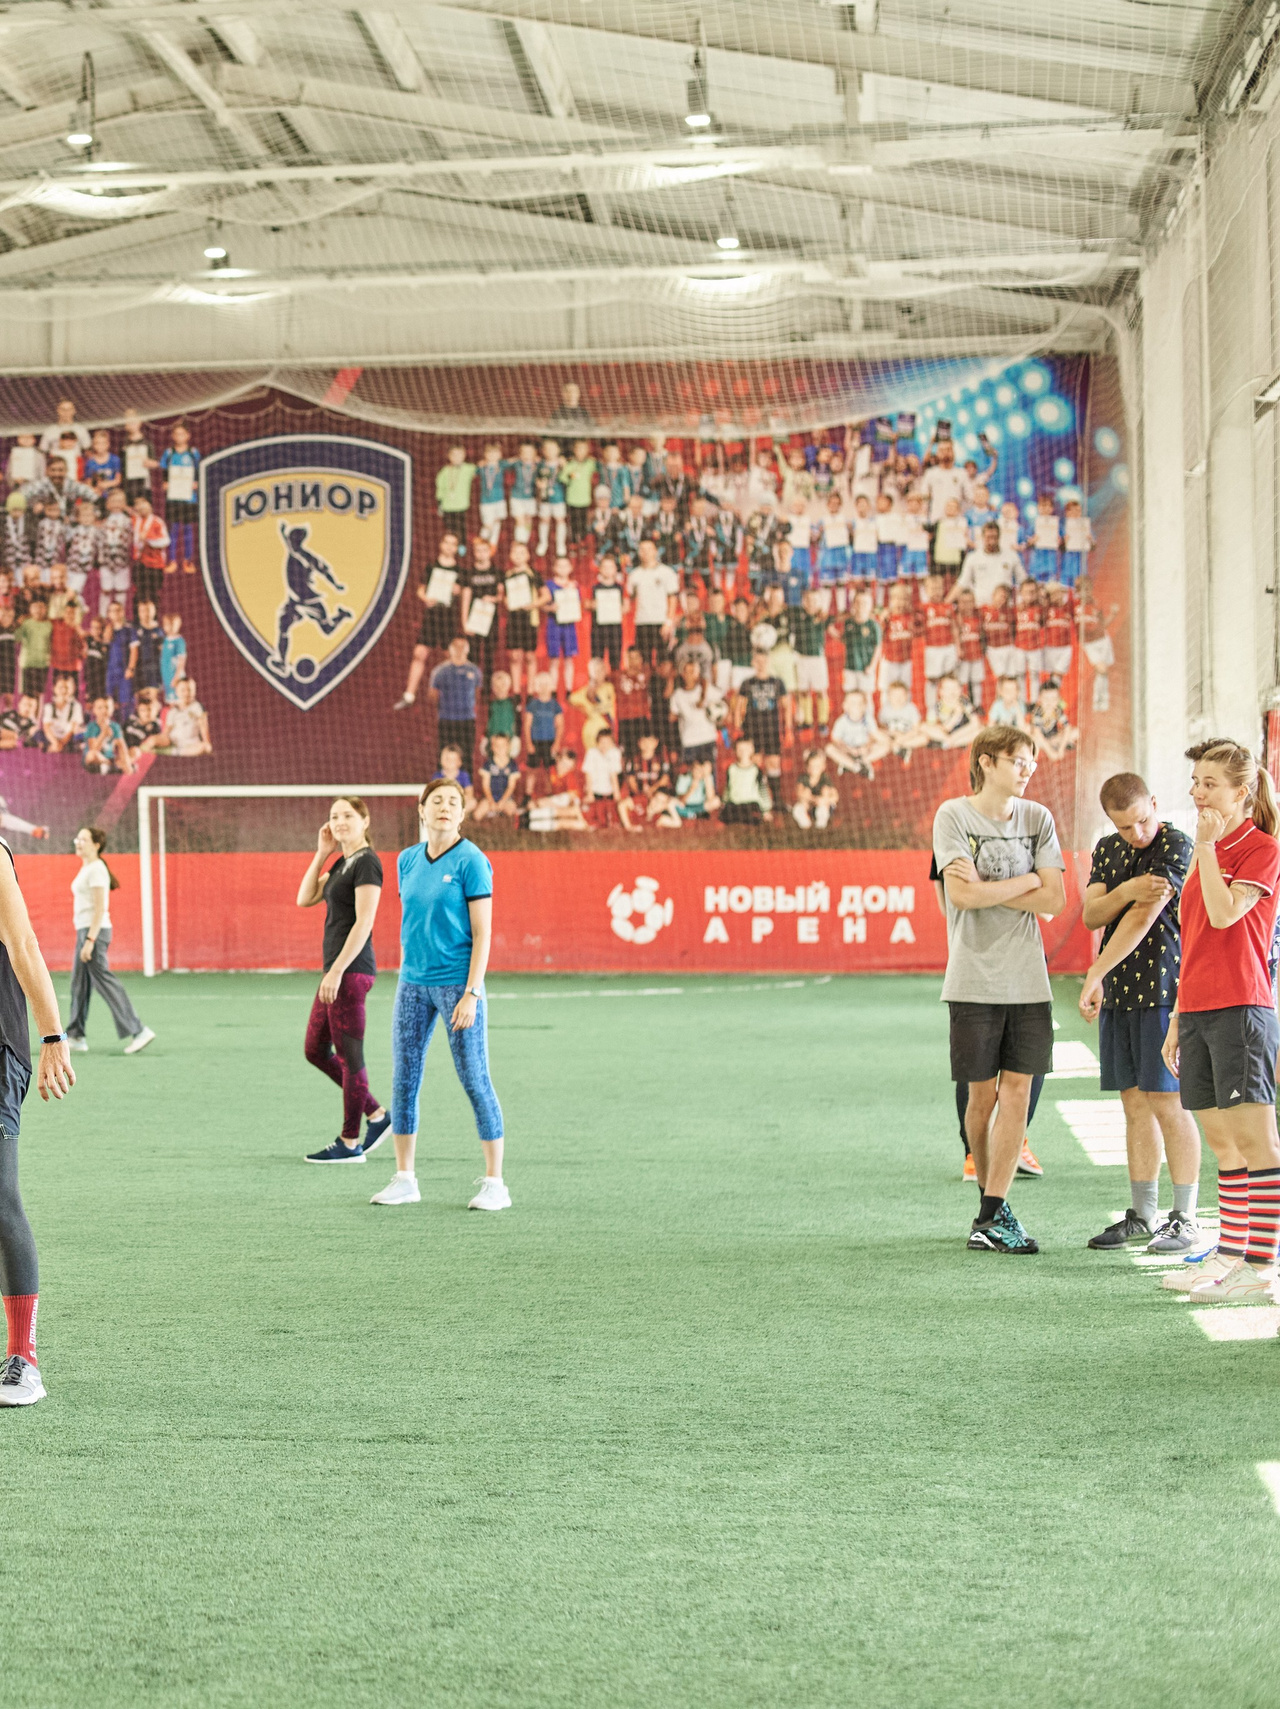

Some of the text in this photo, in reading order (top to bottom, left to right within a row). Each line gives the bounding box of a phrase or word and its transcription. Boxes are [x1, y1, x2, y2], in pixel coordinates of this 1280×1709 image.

[233, 481, 377, 522] ЮНИОР
[704, 881, 916, 917] НОВЫЙ ДОМ
[703, 916, 917, 943] АРЕНА
